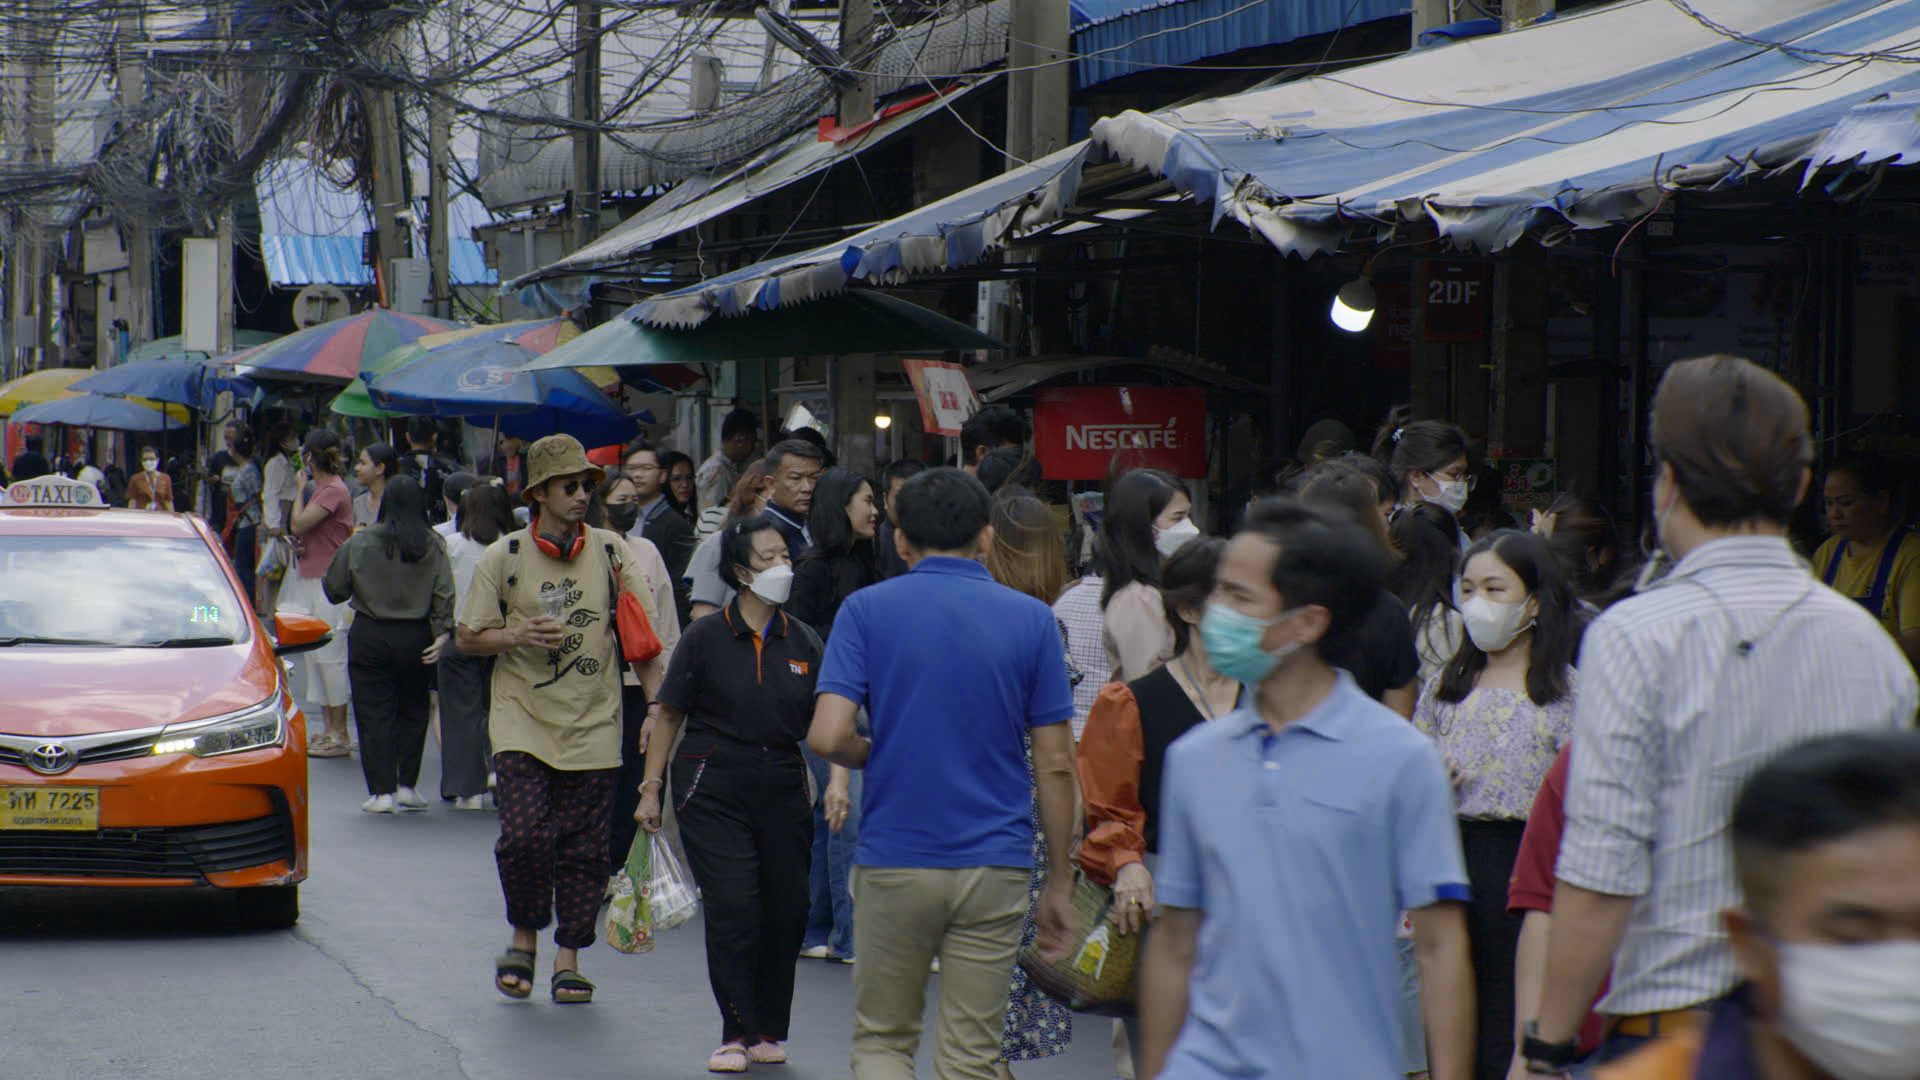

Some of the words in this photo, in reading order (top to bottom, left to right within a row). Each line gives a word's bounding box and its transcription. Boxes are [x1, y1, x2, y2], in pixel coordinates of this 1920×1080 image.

[1065, 417, 1177, 450] NESCAFÉ
[31, 485, 73, 503] TAXI
[47, 791, 96, 810] 7225
